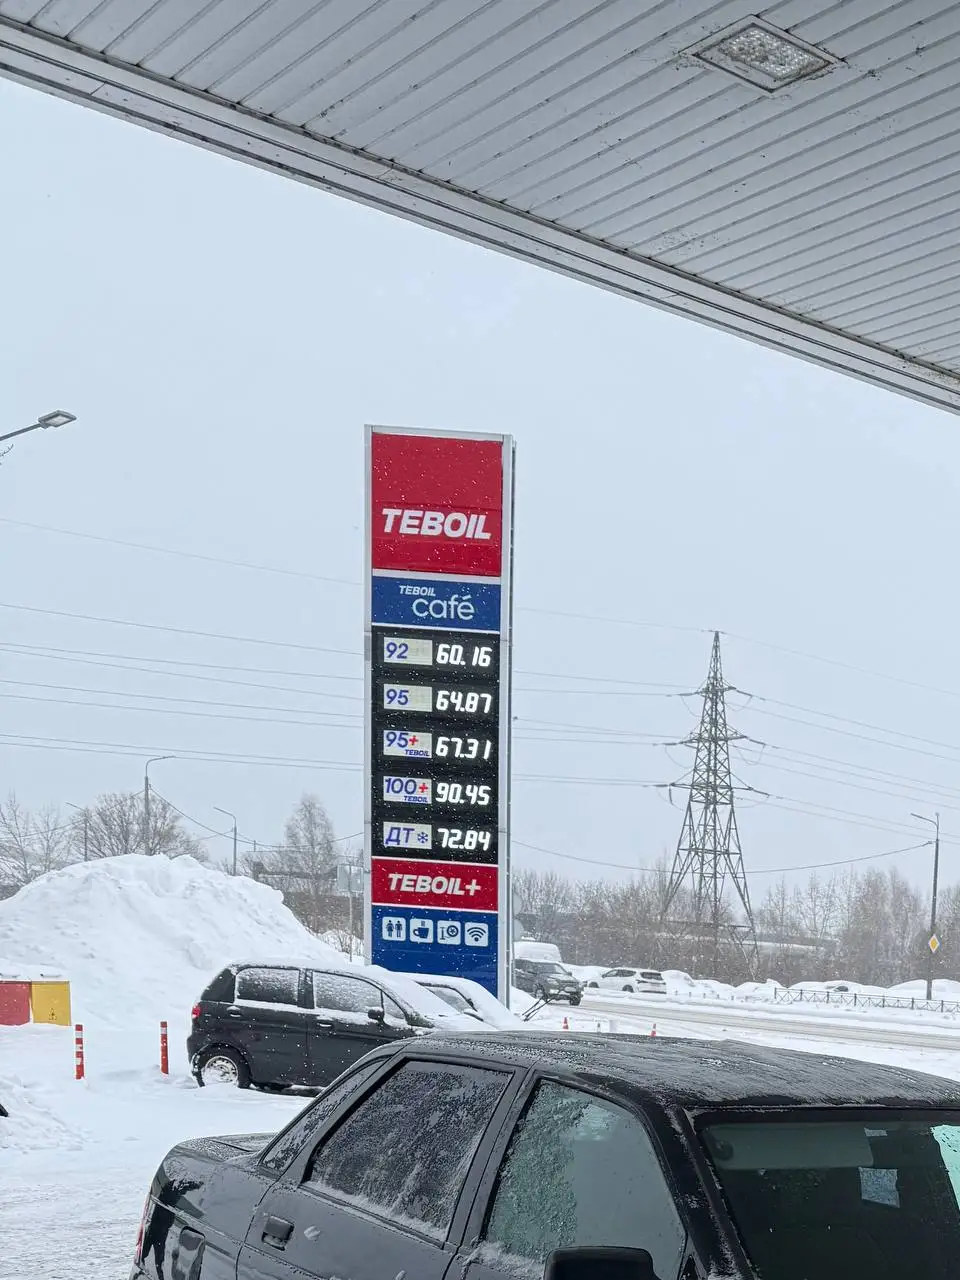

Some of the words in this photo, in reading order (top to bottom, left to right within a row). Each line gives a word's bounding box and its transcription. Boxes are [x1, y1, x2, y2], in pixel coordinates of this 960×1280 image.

[381, 507, 493, 541] TEBOIL
[399, 584, 437, 598] TEBOIL
[411, 593, 475, 621] café
[385, 641, 410, 660] 92
[435, 643, 493, 668] 60.16
[385, 688, 410, 707] 95
[435, 689, 493, 714] 64.87
[404, 748, 431, 757] TEBOIL
[435, 736, 492, 761] 67.31
[403, 795, 429, 803] TEBOIL
[435, 782, 492, 806] 90.45
[384, 826, 415, 846] ДТ
[437, 828, 492, 852] 72.84
[388, 872, 482, 897] TEBOIL+
